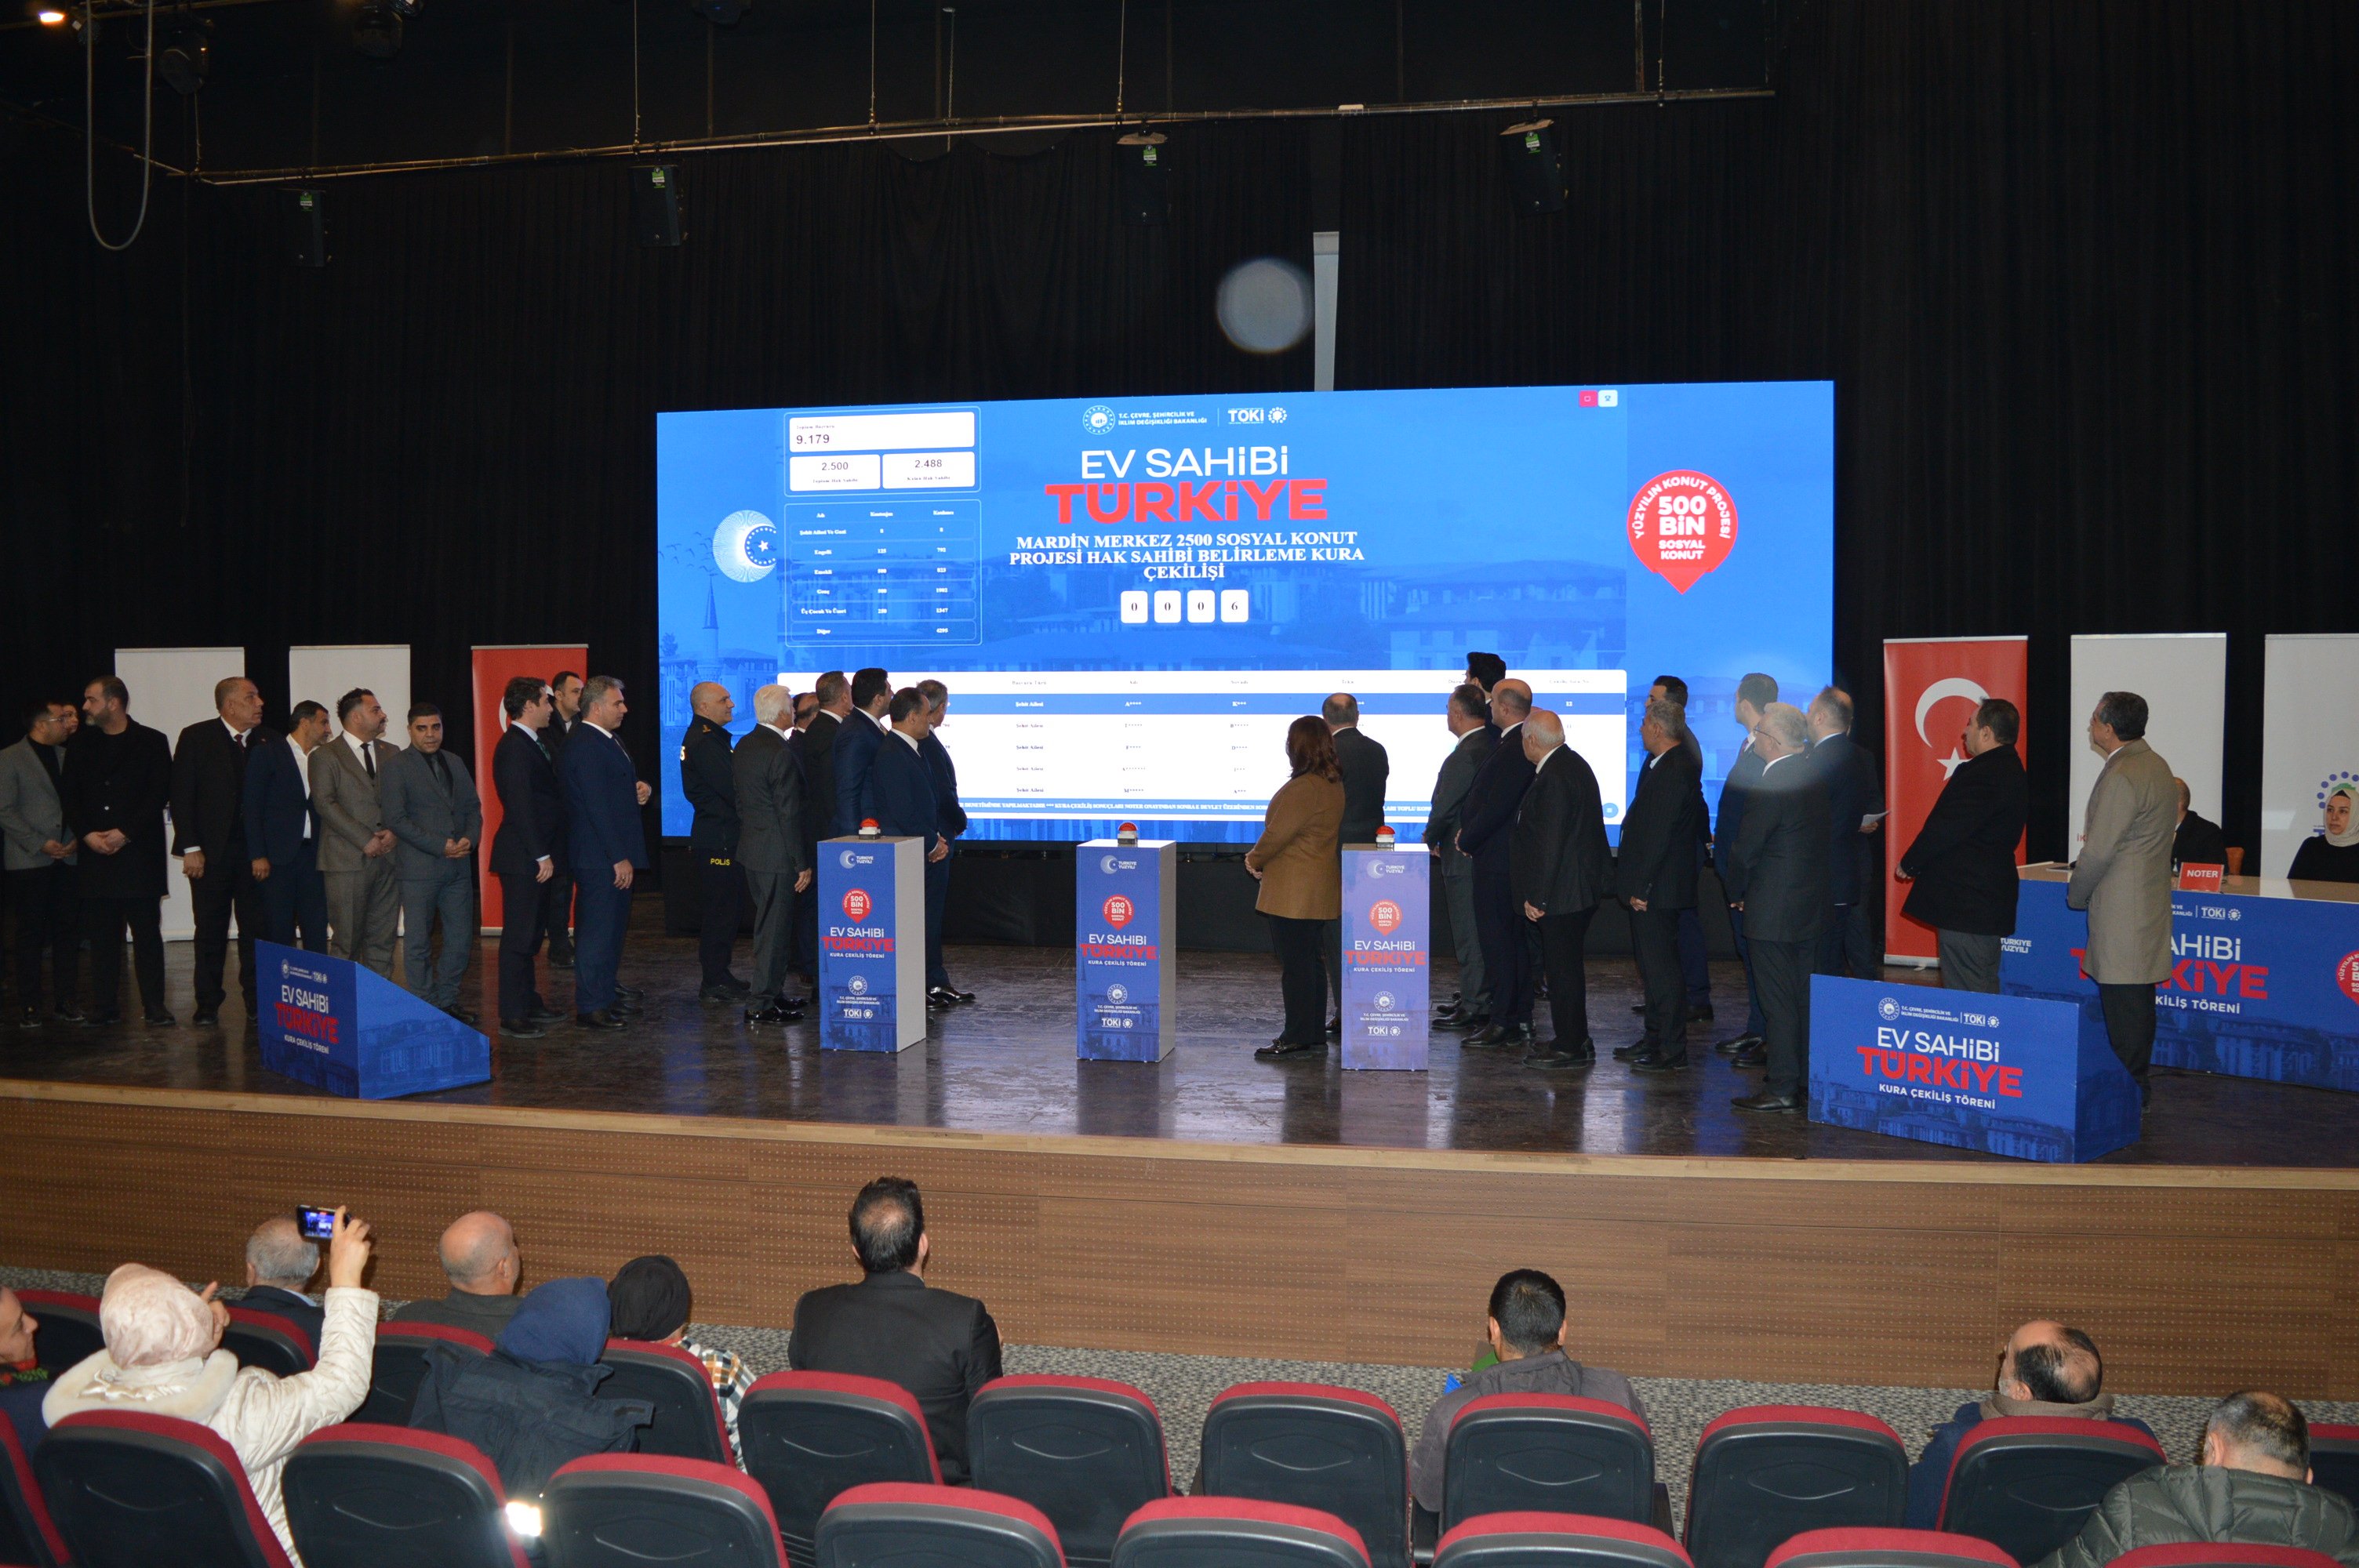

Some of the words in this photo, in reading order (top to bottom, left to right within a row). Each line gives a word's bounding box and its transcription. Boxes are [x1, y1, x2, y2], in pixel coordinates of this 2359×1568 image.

[796, 434, 830, 445] 9.179
[822, 462, 849, 470] 2.500
[914, 459, 942, 468] 2.488
[1081, 449, 1136, 479] EV
[1632, 485, 1662, 539] YÜZYILIN
[1662, 476, 1708, 491] KONUT
[1658, 495, 1707, 515] 500
[1016, 535, 1089, 550] MARDİN
[1093, 535, 1172, 548] MERKEZ
[1176, 534, 1212, 546] 2500
[1216, 533, 1287, 546] SOSYAL
[1291, 532, 1358, 546] KONUT
[1659, 539, 1706, 550] SOSYAL
[1009, 550, 1083, 565] PROJESİ
[1086, 551, 1126, 564] HAK
[1131, 549, 1193, 563] SAHİBİ
[1198, 548, 1307, 562] BELİRLEME
[1311, 548, 1364, 561] KURA
[1660, 550, 1703, 560] KONUT
[1143, 565, 1225, 581] ÇEKİLİŞİ
[1130, 602, 1138, 612] 0
[1164, 602, 1171, 612] 0
[1198, 601, 1205, 612] 0
[1230, 601, 1238, 612] 6
[830, 927, 845, 936] EV
[1089, 934, 1104, 943] EV
[1355, 941, 1372, 950] EV
[282, 985, 295, 1004] EV
[2155, 995, 2187, 1009] KİLİŞ
[284, 1034, 296, 1044] KURA
[1877, 1026, 1910, 1050] EV
[1879, 1083, 1907, 1097] KURA
[1911, 1088, 1952, 1103] ÇEKİLİŞ
[1955, 1094, 1996, 1110] TÖRENİ
